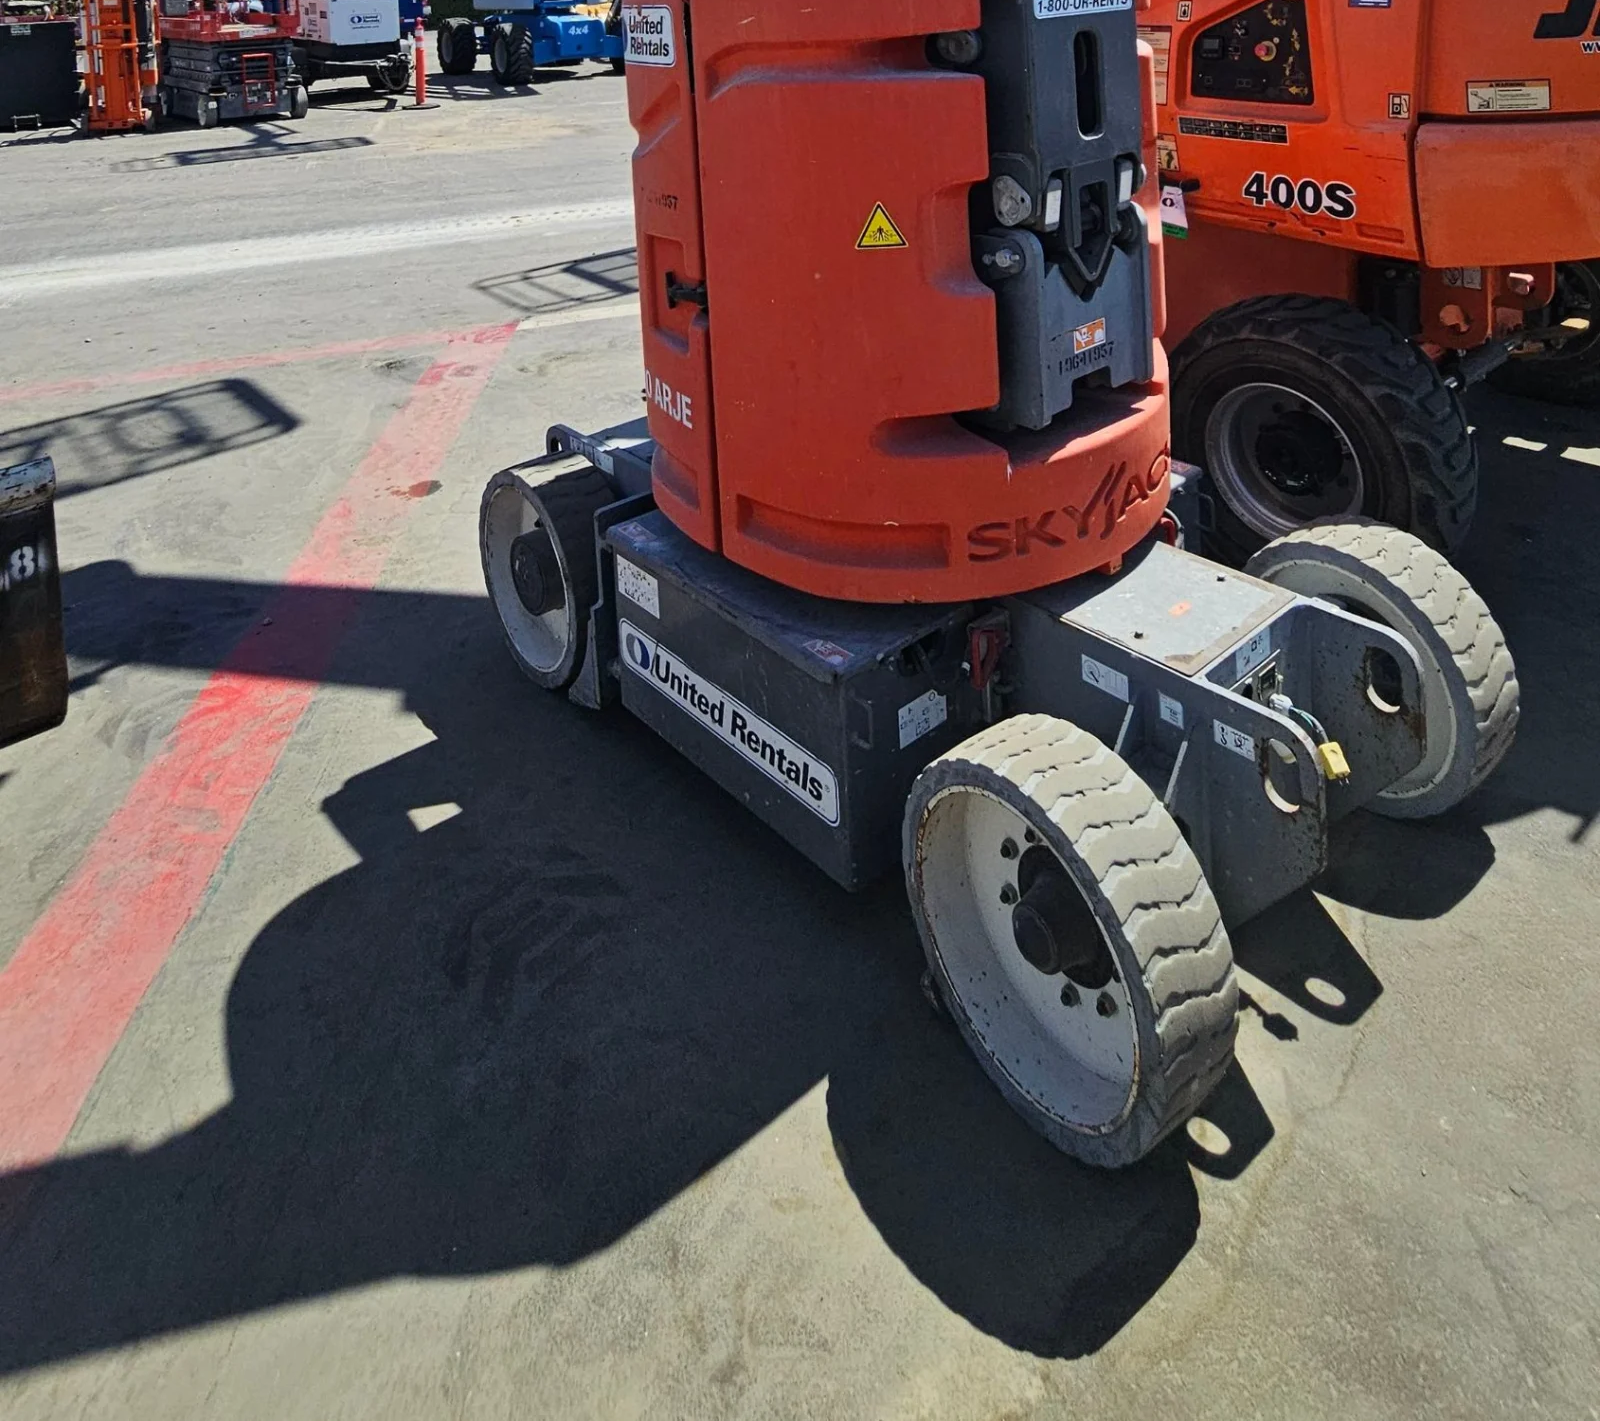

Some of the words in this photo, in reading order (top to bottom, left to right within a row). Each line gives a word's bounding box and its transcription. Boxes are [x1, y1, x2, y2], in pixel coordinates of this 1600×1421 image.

[568, 25, 589, 35] 4x4
[629, 15, 663, 35] United
[630, 37, 670, 57] Rentals
[1243, 171, 1356, 220] 400S
[654, 383, 693, 429] ARJE
[655, 653, 724, 728] United
[730, 709, 823, 802] Rentals
